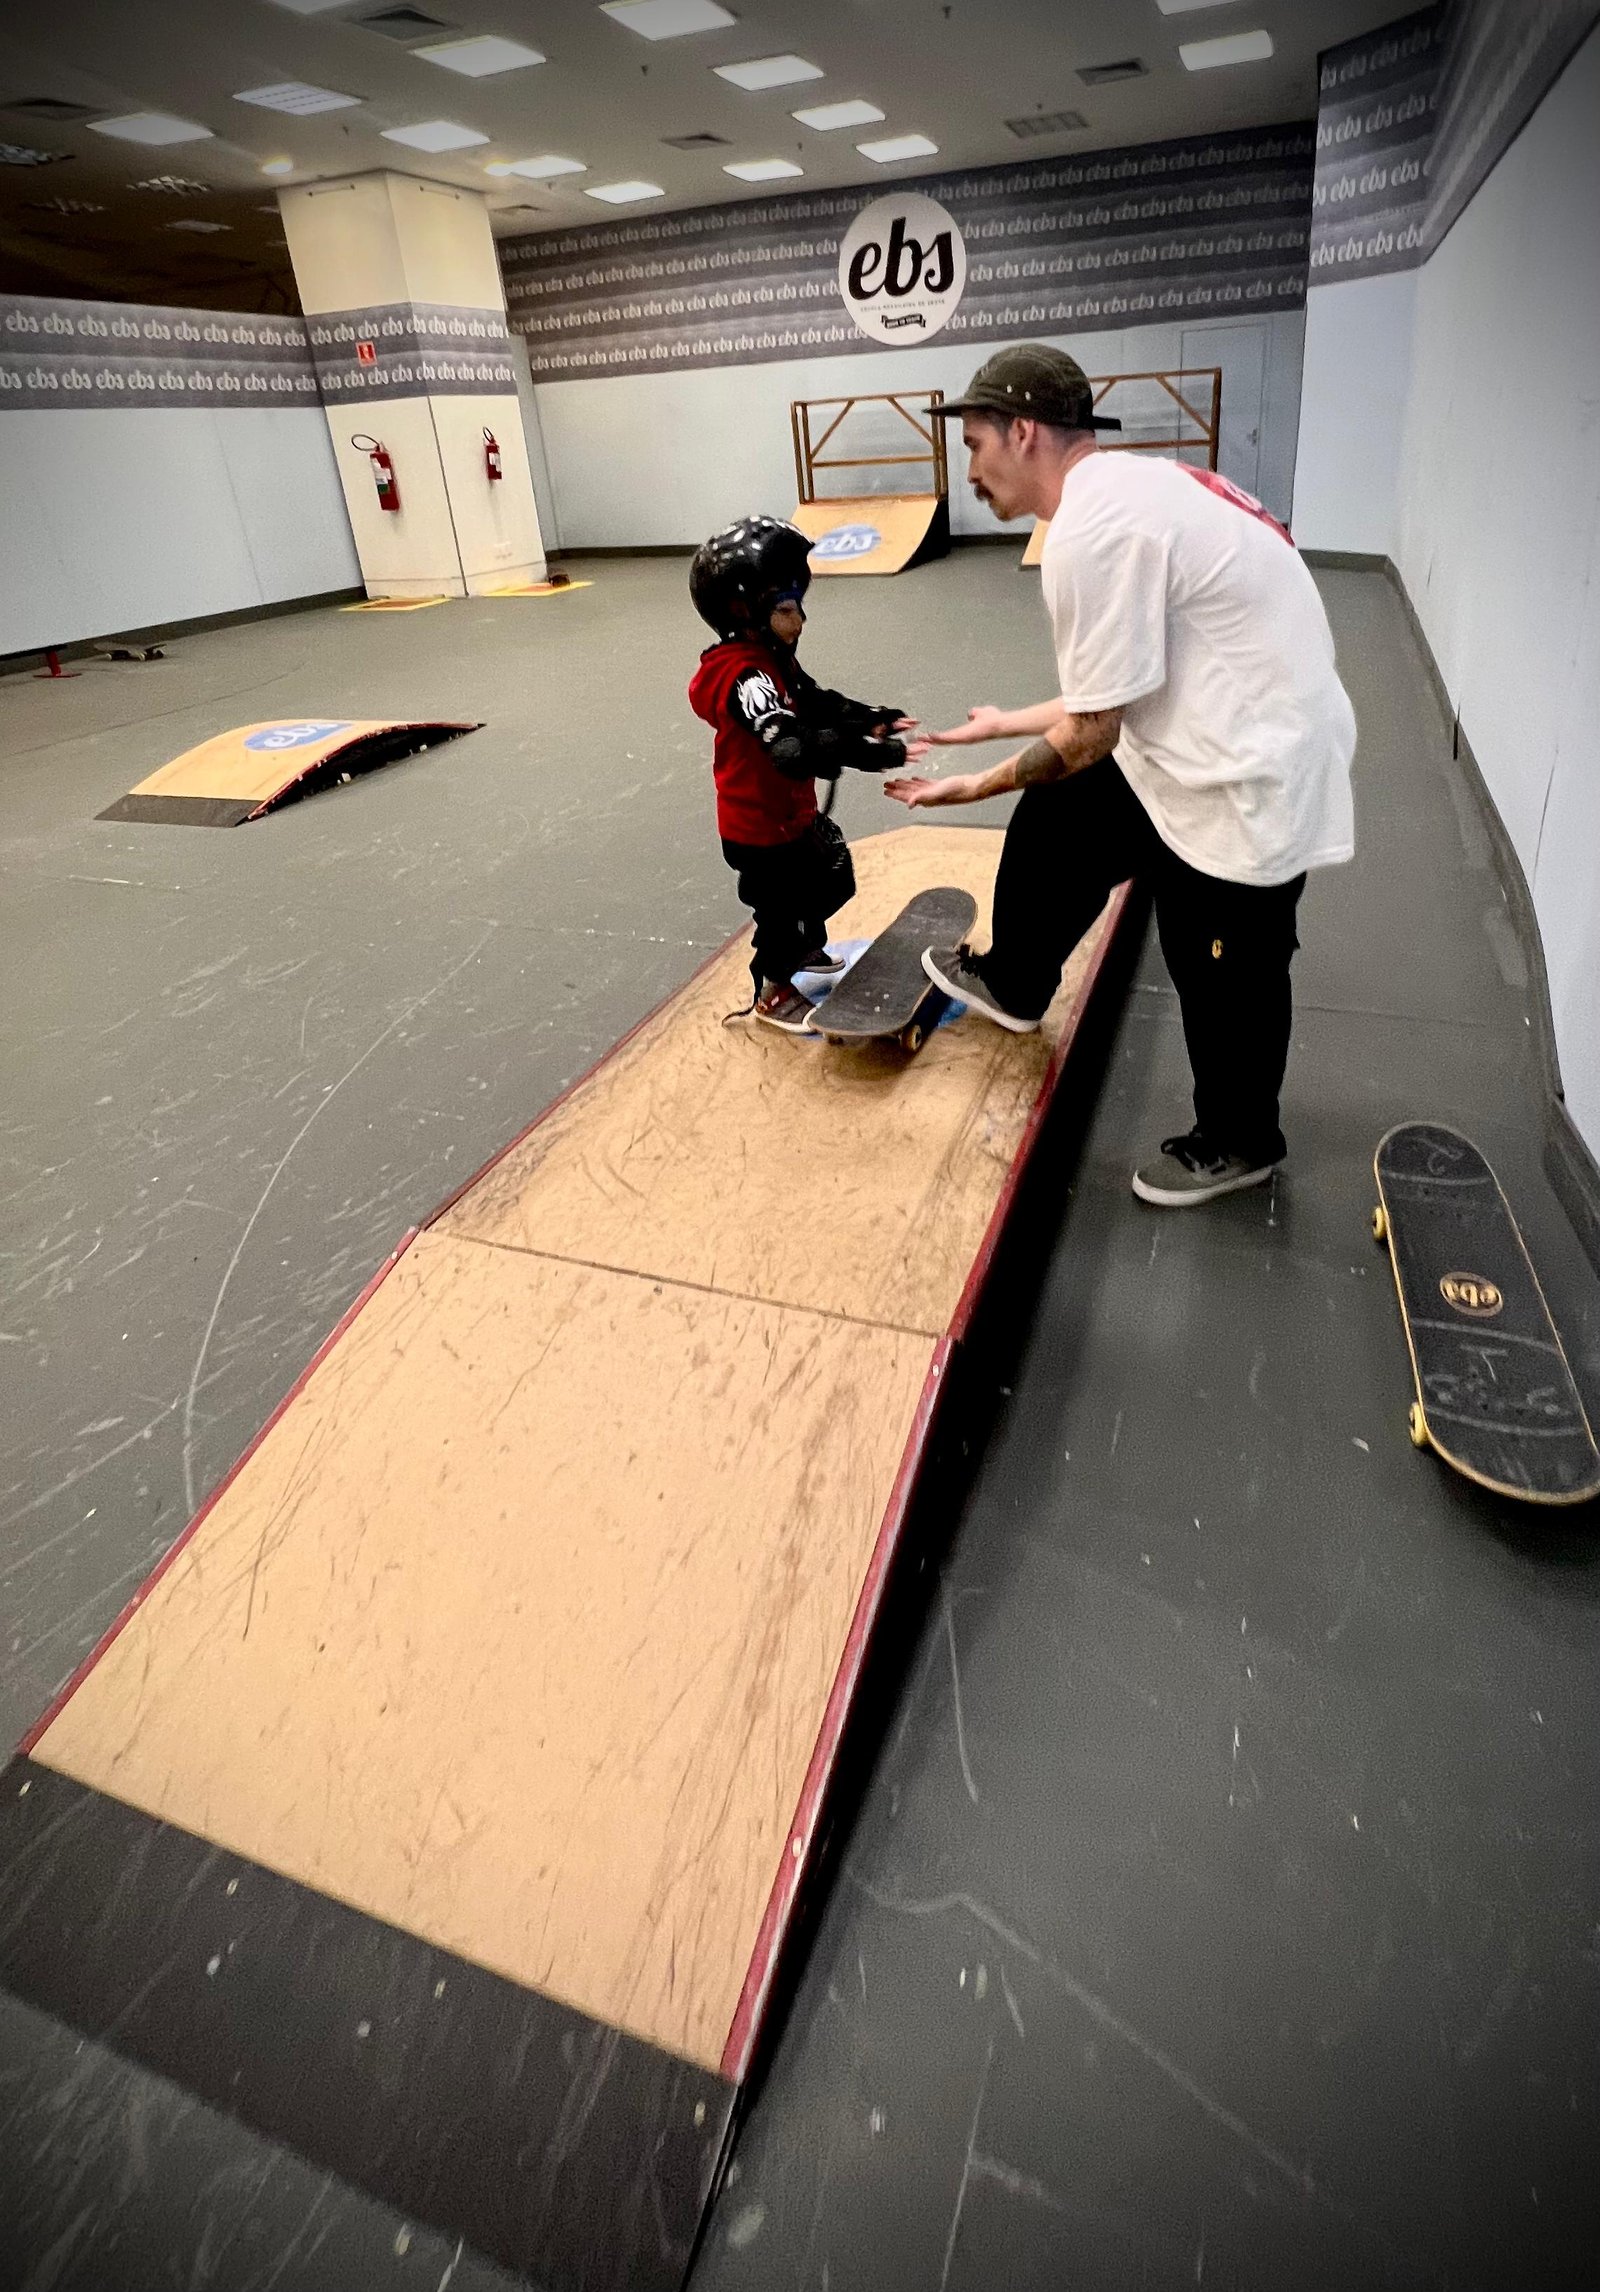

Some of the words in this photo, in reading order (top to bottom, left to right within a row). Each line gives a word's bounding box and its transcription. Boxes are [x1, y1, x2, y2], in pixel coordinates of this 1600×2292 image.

[848, 217, 954, 300] ebs
[0, 367, 22, 389] bs
[815, 533, 872, 554] ebs
[264, 723, 338, 748] ebs
